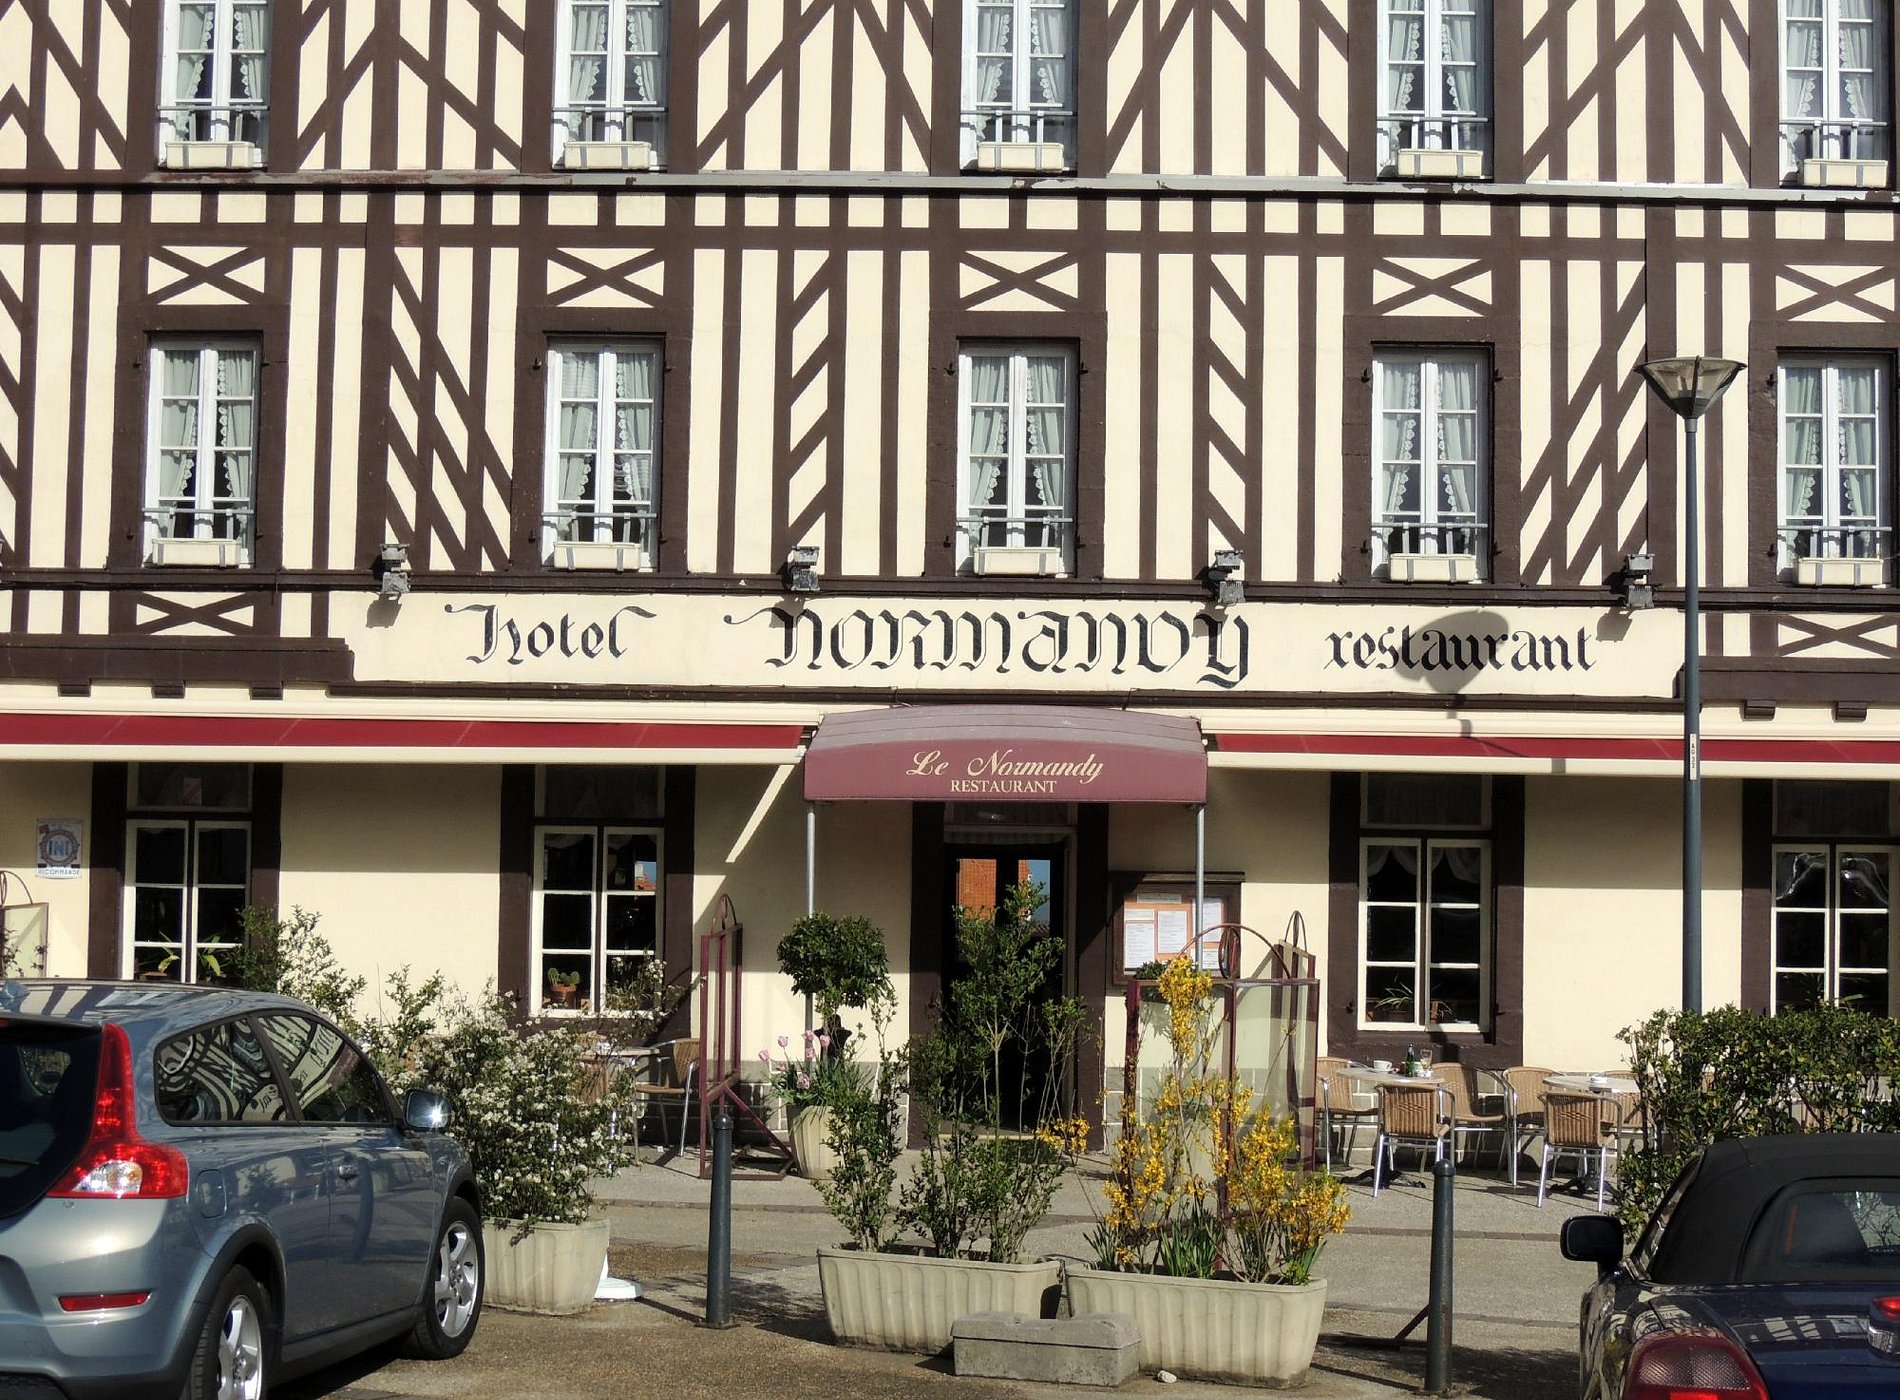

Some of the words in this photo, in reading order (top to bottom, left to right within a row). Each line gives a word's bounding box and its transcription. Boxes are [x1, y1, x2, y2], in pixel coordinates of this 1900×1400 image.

[1323, 624, 1597, 672] restaurant
[906, 750, 949, 776] Le
[967, 749, 1104, 784] Normandy
[951, 779, 1057, 793] RESTAURANT
